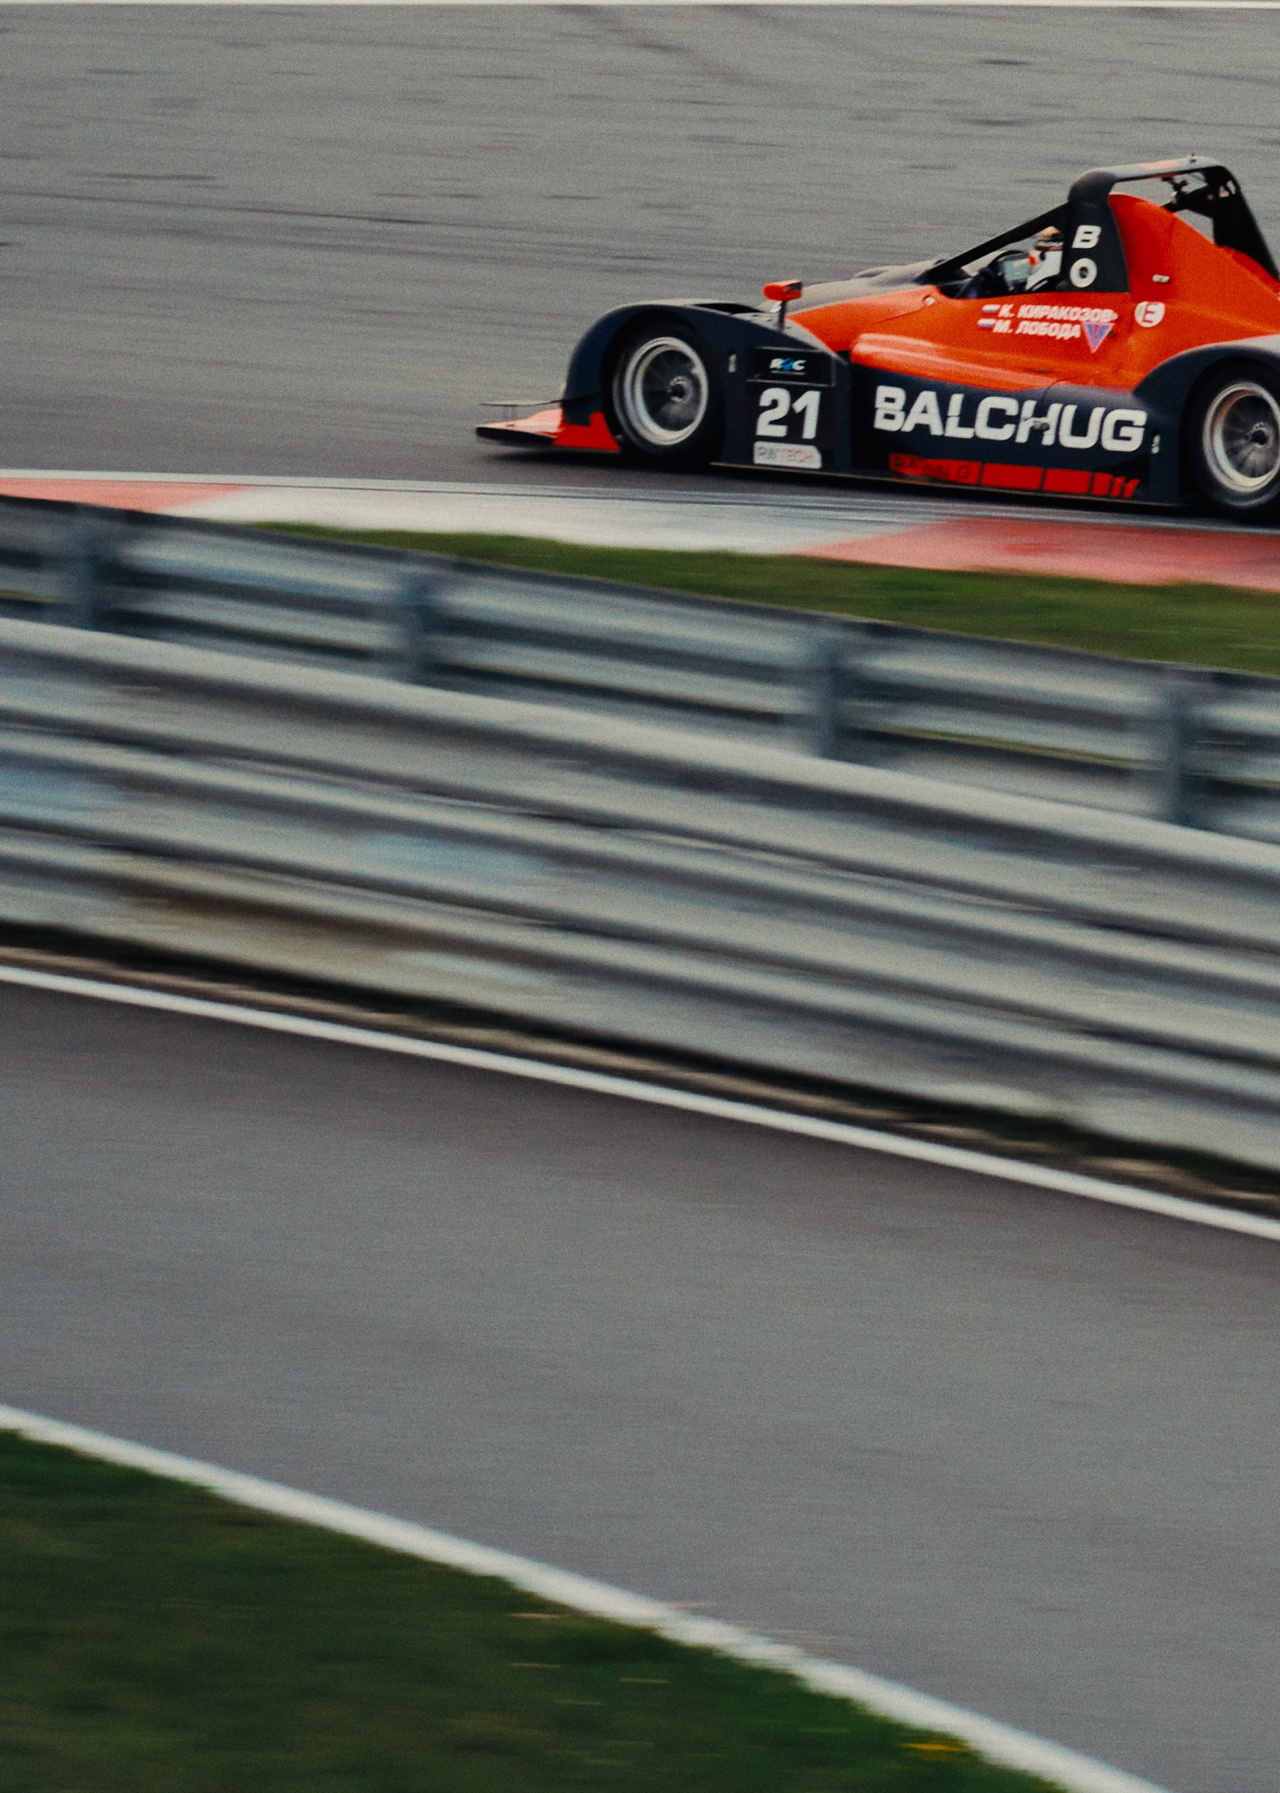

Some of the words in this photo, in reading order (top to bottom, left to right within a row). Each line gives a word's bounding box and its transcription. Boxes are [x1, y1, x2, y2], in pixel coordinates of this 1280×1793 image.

[1016, 320, 1081, 340] ЛОБОДА
[756, 387, 821, 440] 21
[873, 385, 1148, 452] BALCHUG
